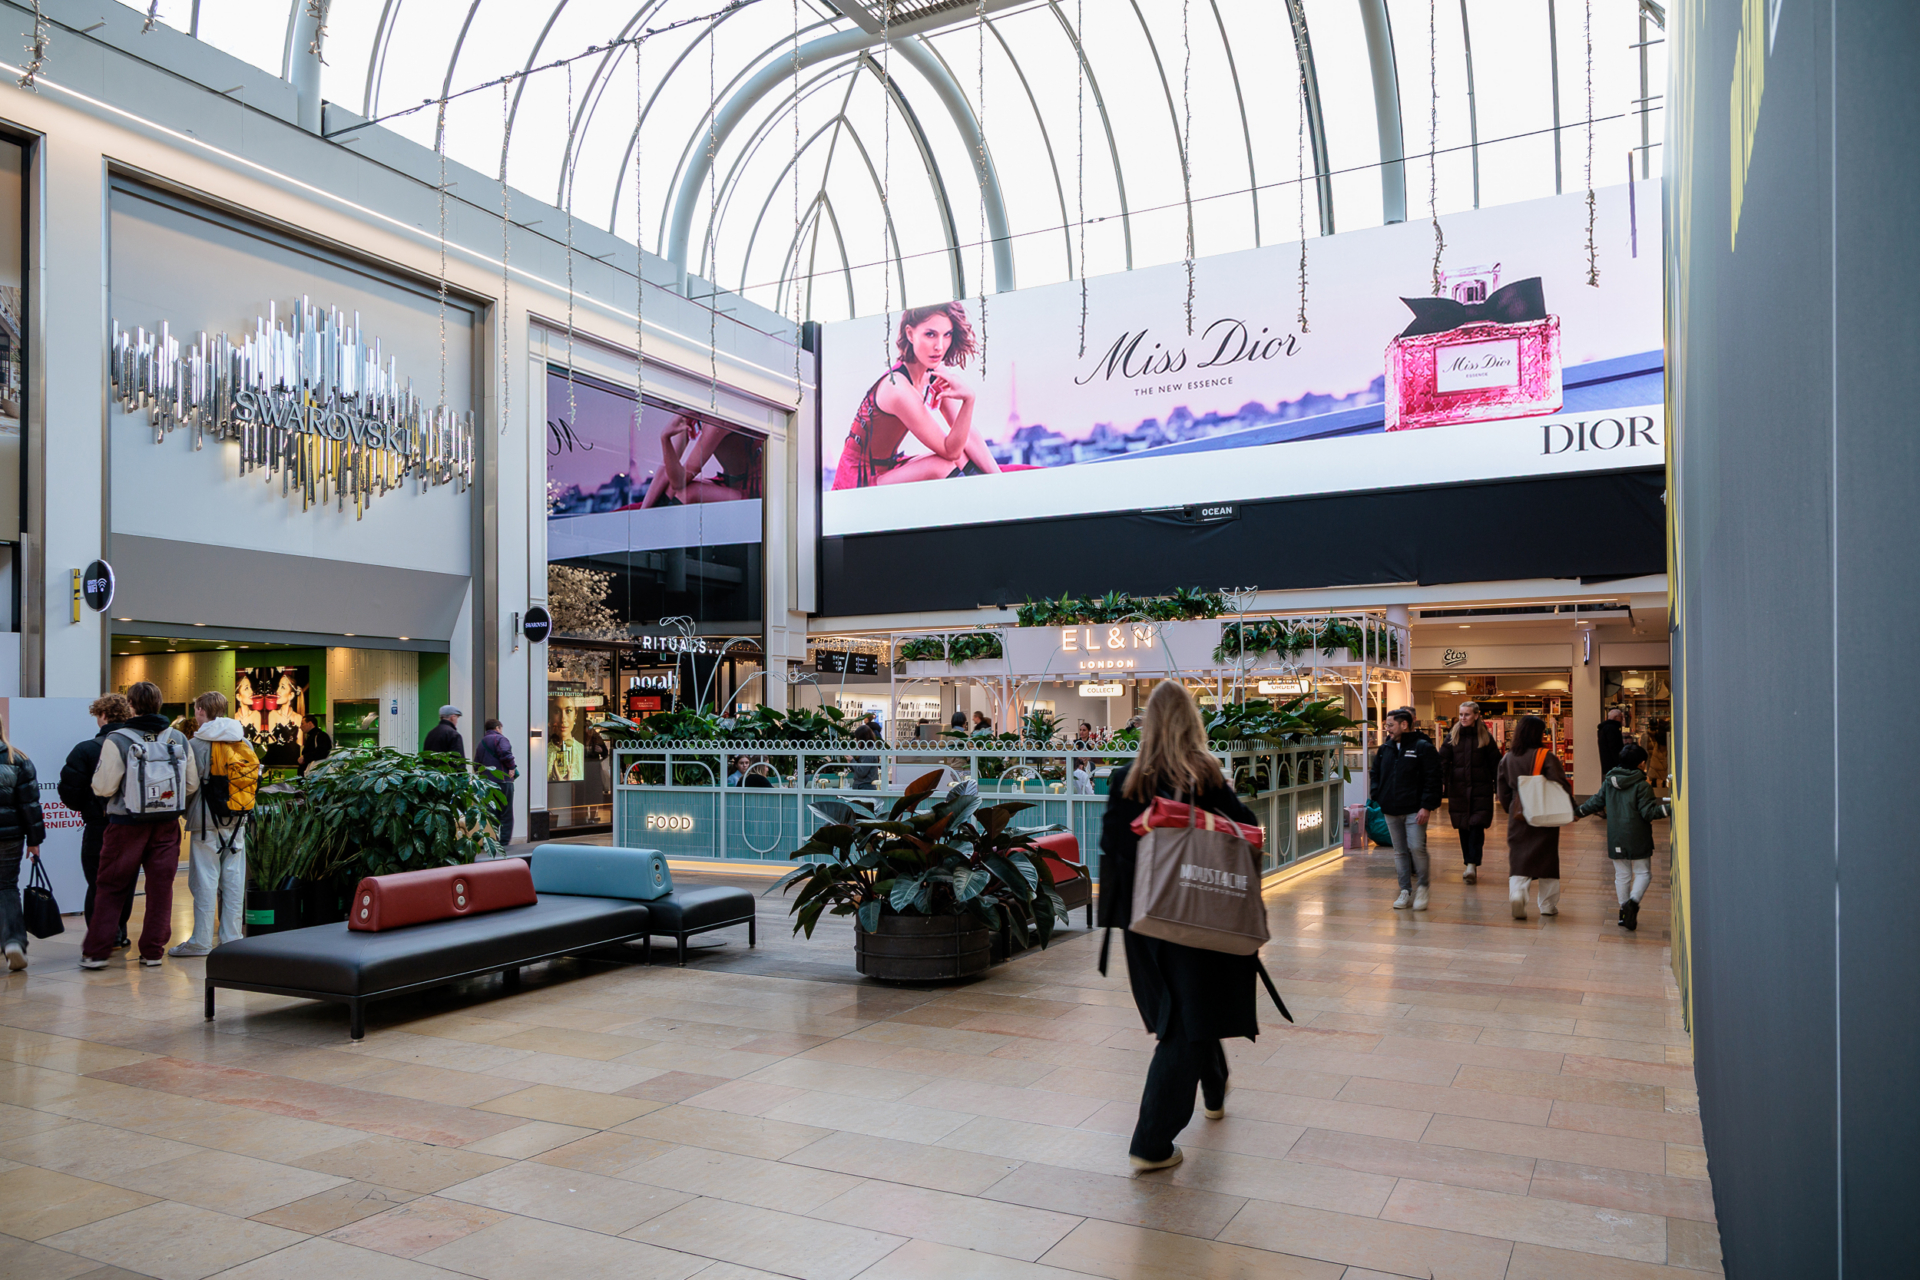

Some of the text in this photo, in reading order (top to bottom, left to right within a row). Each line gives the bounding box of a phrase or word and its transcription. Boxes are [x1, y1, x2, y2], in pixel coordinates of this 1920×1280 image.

[1074, 317, 1302, 386] Miss Dior
[1442, 353, 1512, 373] Miss Dior
[1134, 376, 1234, 396] THE NEW ESSENCE
[235, 391, 412, 456] SWAROVSKI
[1540, 416, 1660, 455] DIOR
[1202, 506, 1233, 516] OCEAN
[1079, 659, 1135, 669] LONDON
[1443, 648, 1468, 663] Etos
[43, 820, 85, 829] RNIEUW
[646, 814, 692, 830] FOOD
